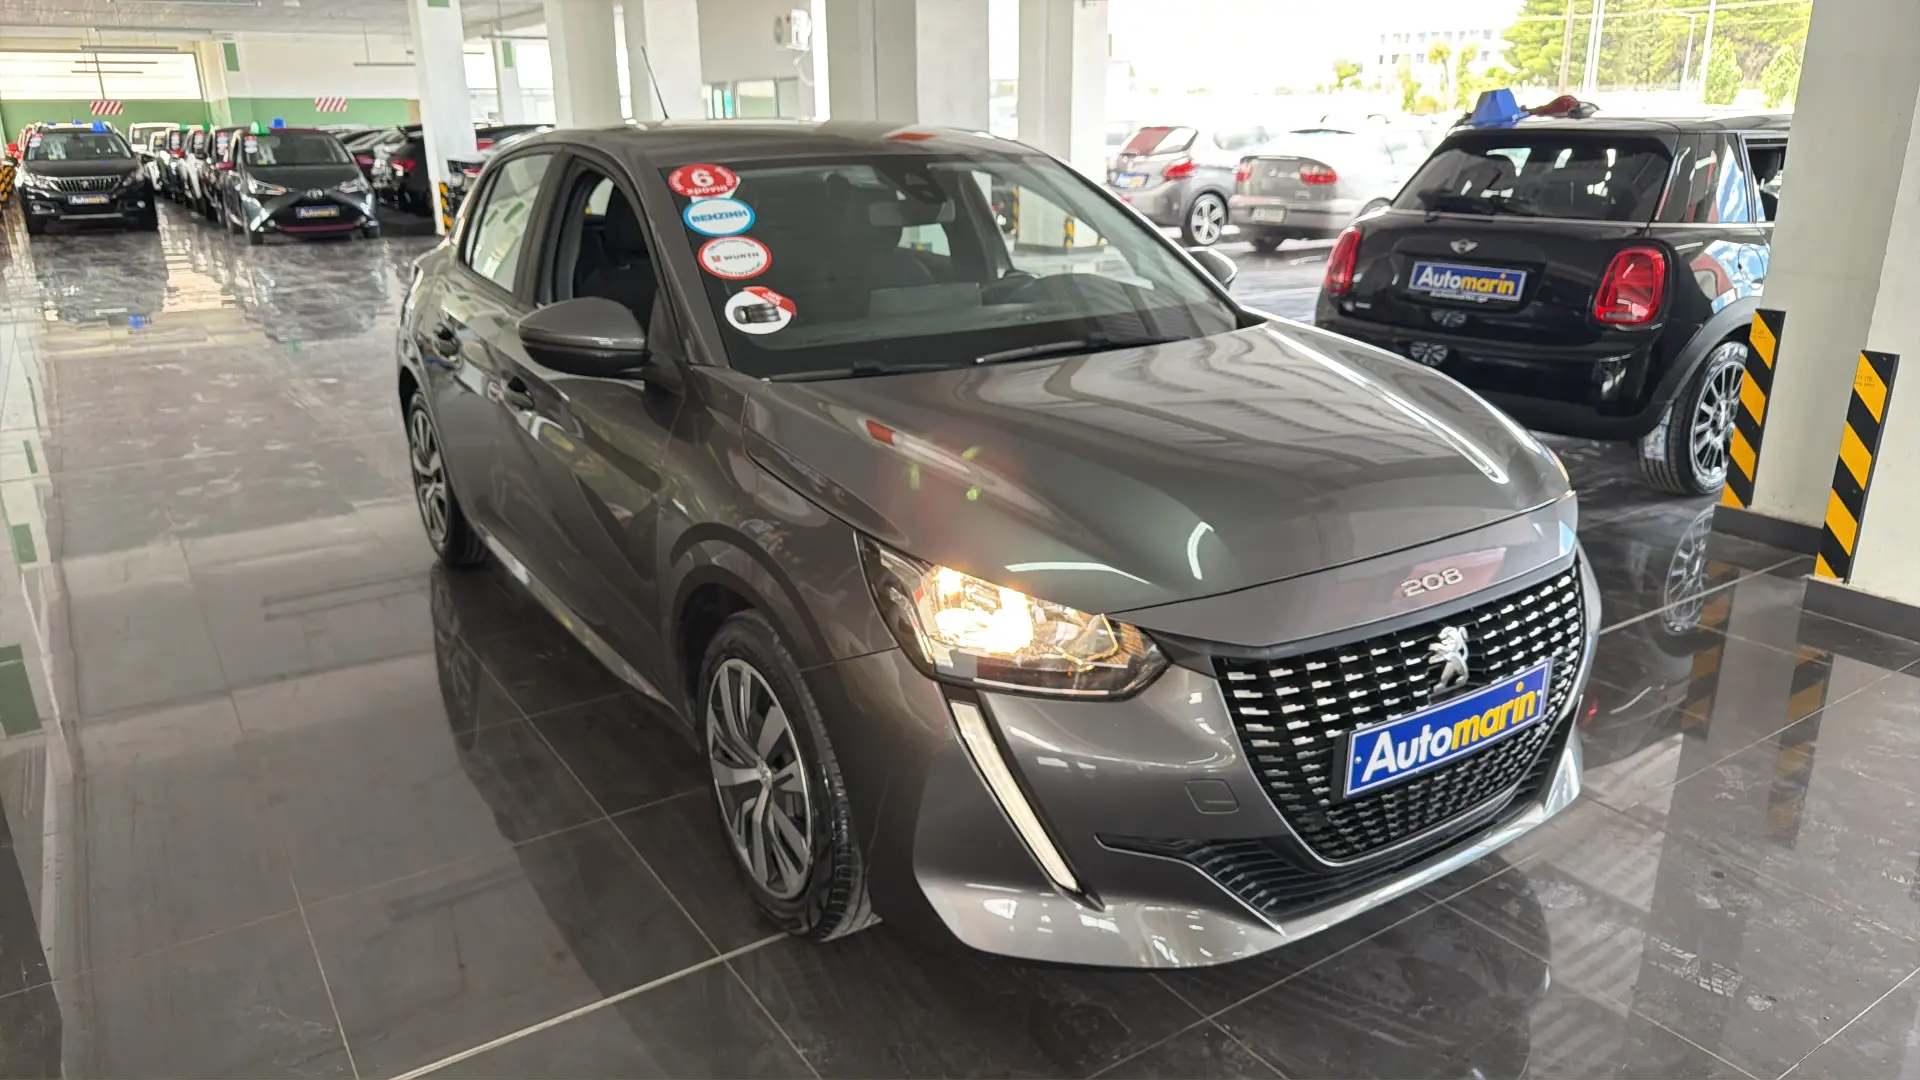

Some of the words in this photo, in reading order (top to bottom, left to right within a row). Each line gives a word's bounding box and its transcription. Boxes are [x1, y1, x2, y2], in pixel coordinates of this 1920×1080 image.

[690, 168, 714, 187] 6
[1417, 267, 1515, 295] Automarin
[1401, 567, 1463, 597] 208
[1361, 681, 1535, 783] Automarin
